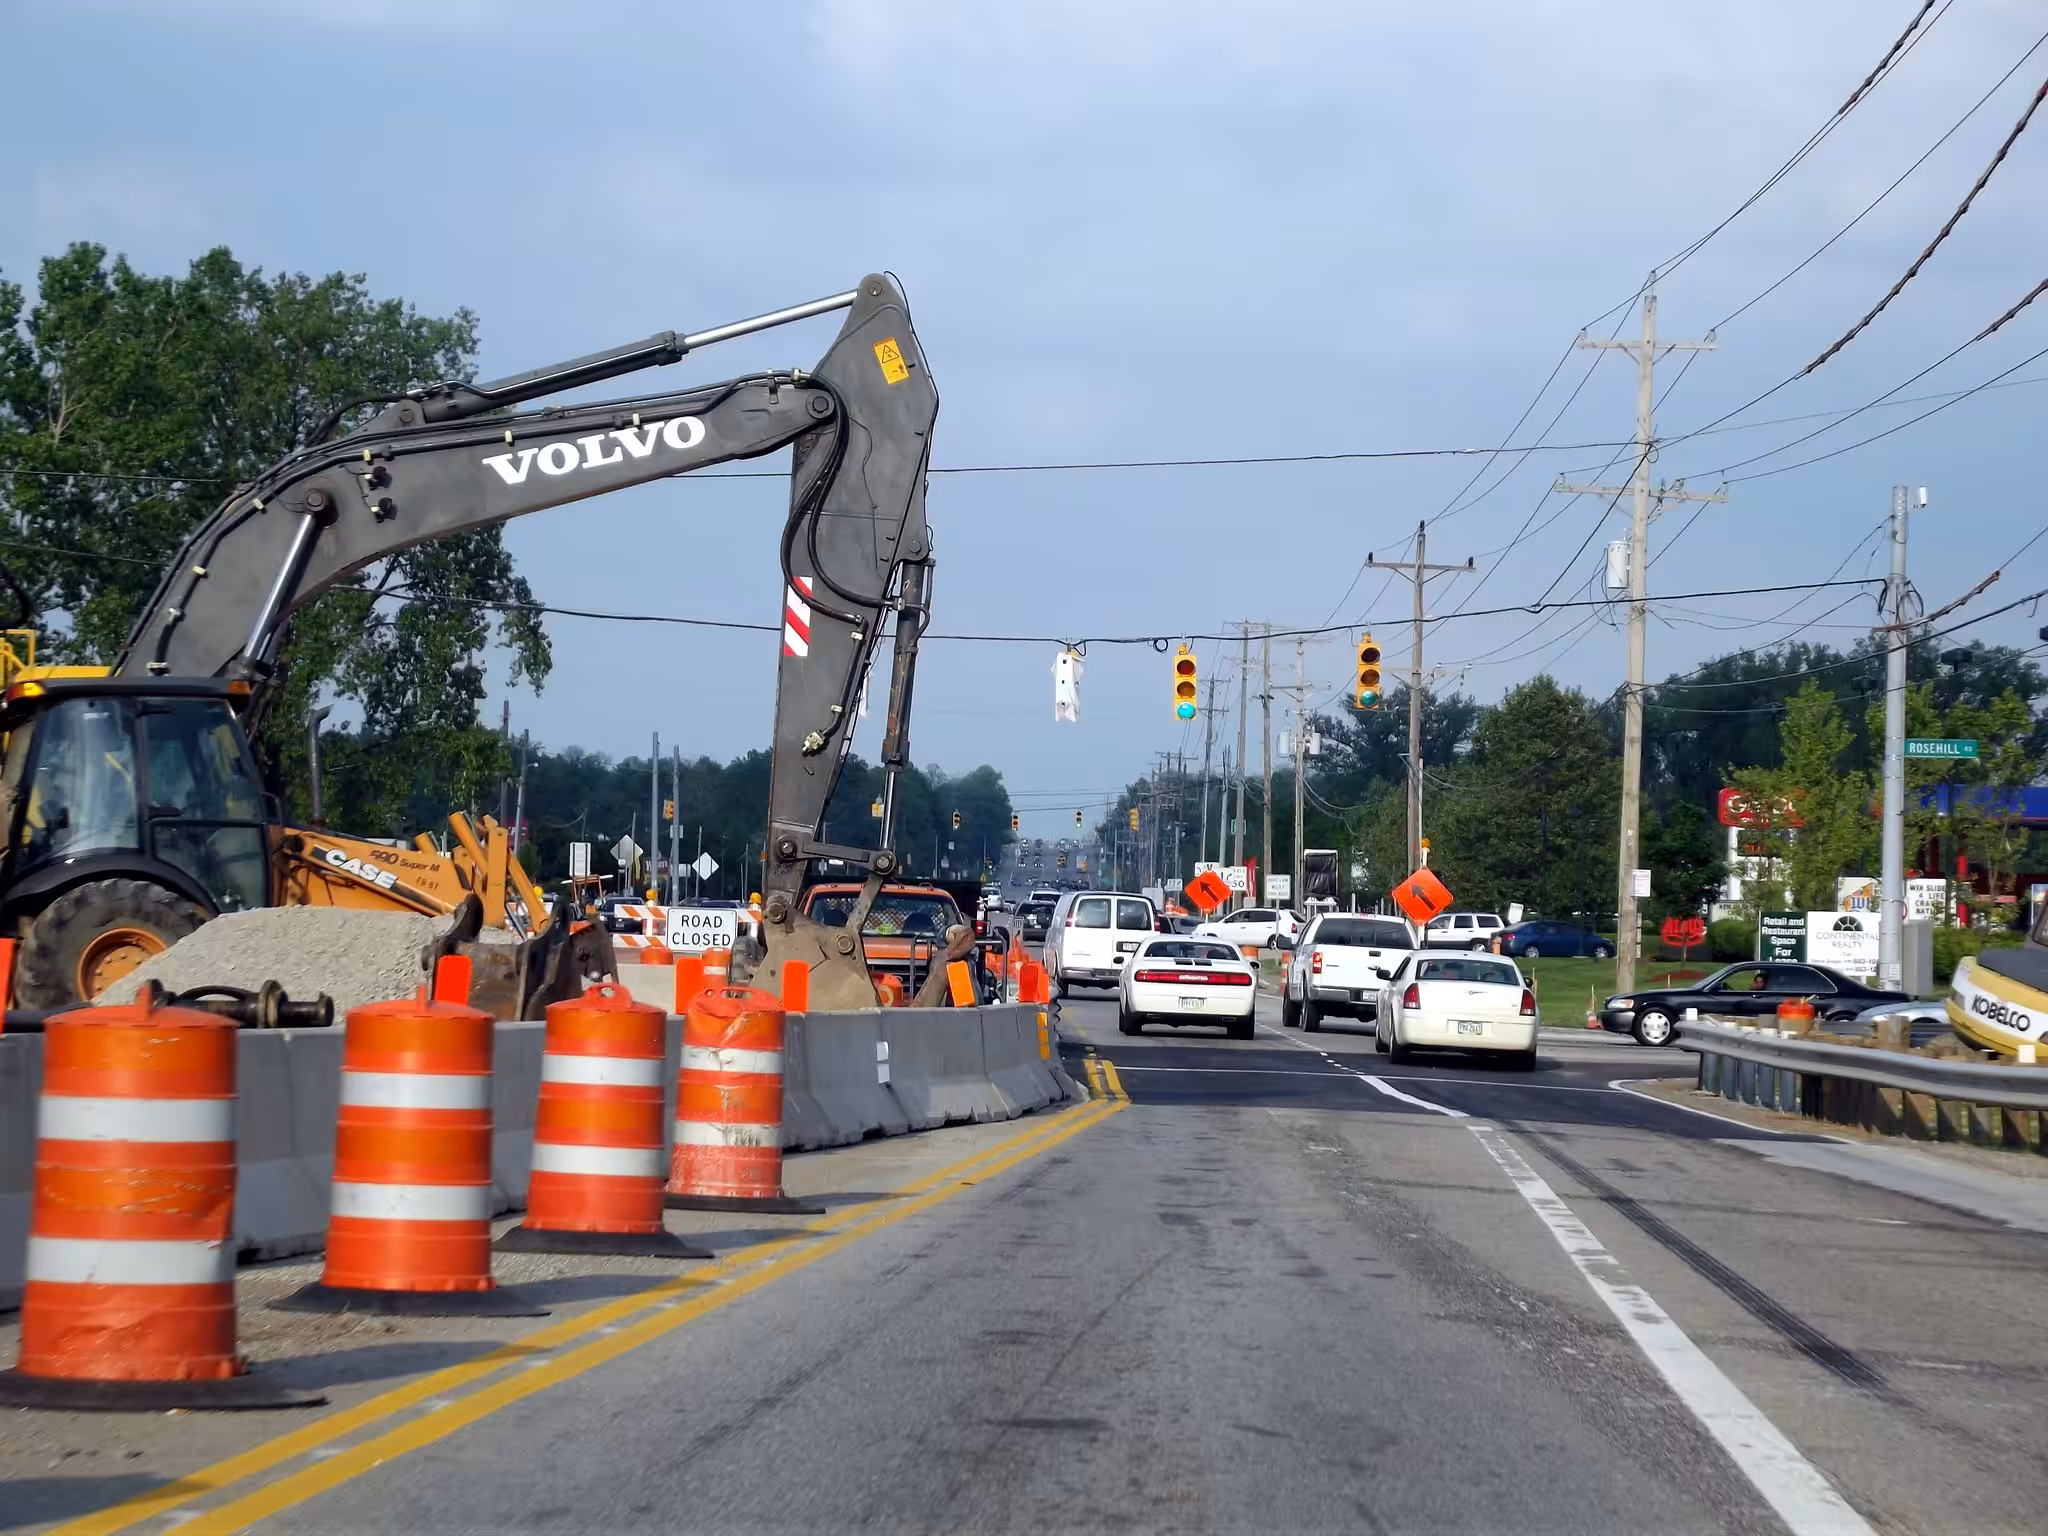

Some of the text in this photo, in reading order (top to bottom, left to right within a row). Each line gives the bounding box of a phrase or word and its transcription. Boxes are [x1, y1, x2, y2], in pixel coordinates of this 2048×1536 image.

[482, 416, 706, 485] VOLVO
[1909, 742, 1960, 754] ROSEHILL
[325, 848, 398, 889] CASE
[400, 858, 428, 869] Super
[429, 863, 440, 872] M
[1232, 880, 1245, 888] 50
[681, 914, 723, 928] ROAD
[1763, 917, 1787, 925] Retail
[1761, 926, 1806, 935] Restaurant
[1816, 931, 1880, 940] CONTINENTAL
[671, 932, 731, 946] CLOSED
[1770, 936, 1797, 946] Space
[1832, 940, 1863, 948] REALTY
[1775, 947, 1792, 956] For
[1971, 994, 2030, 1032] KOBELCO
